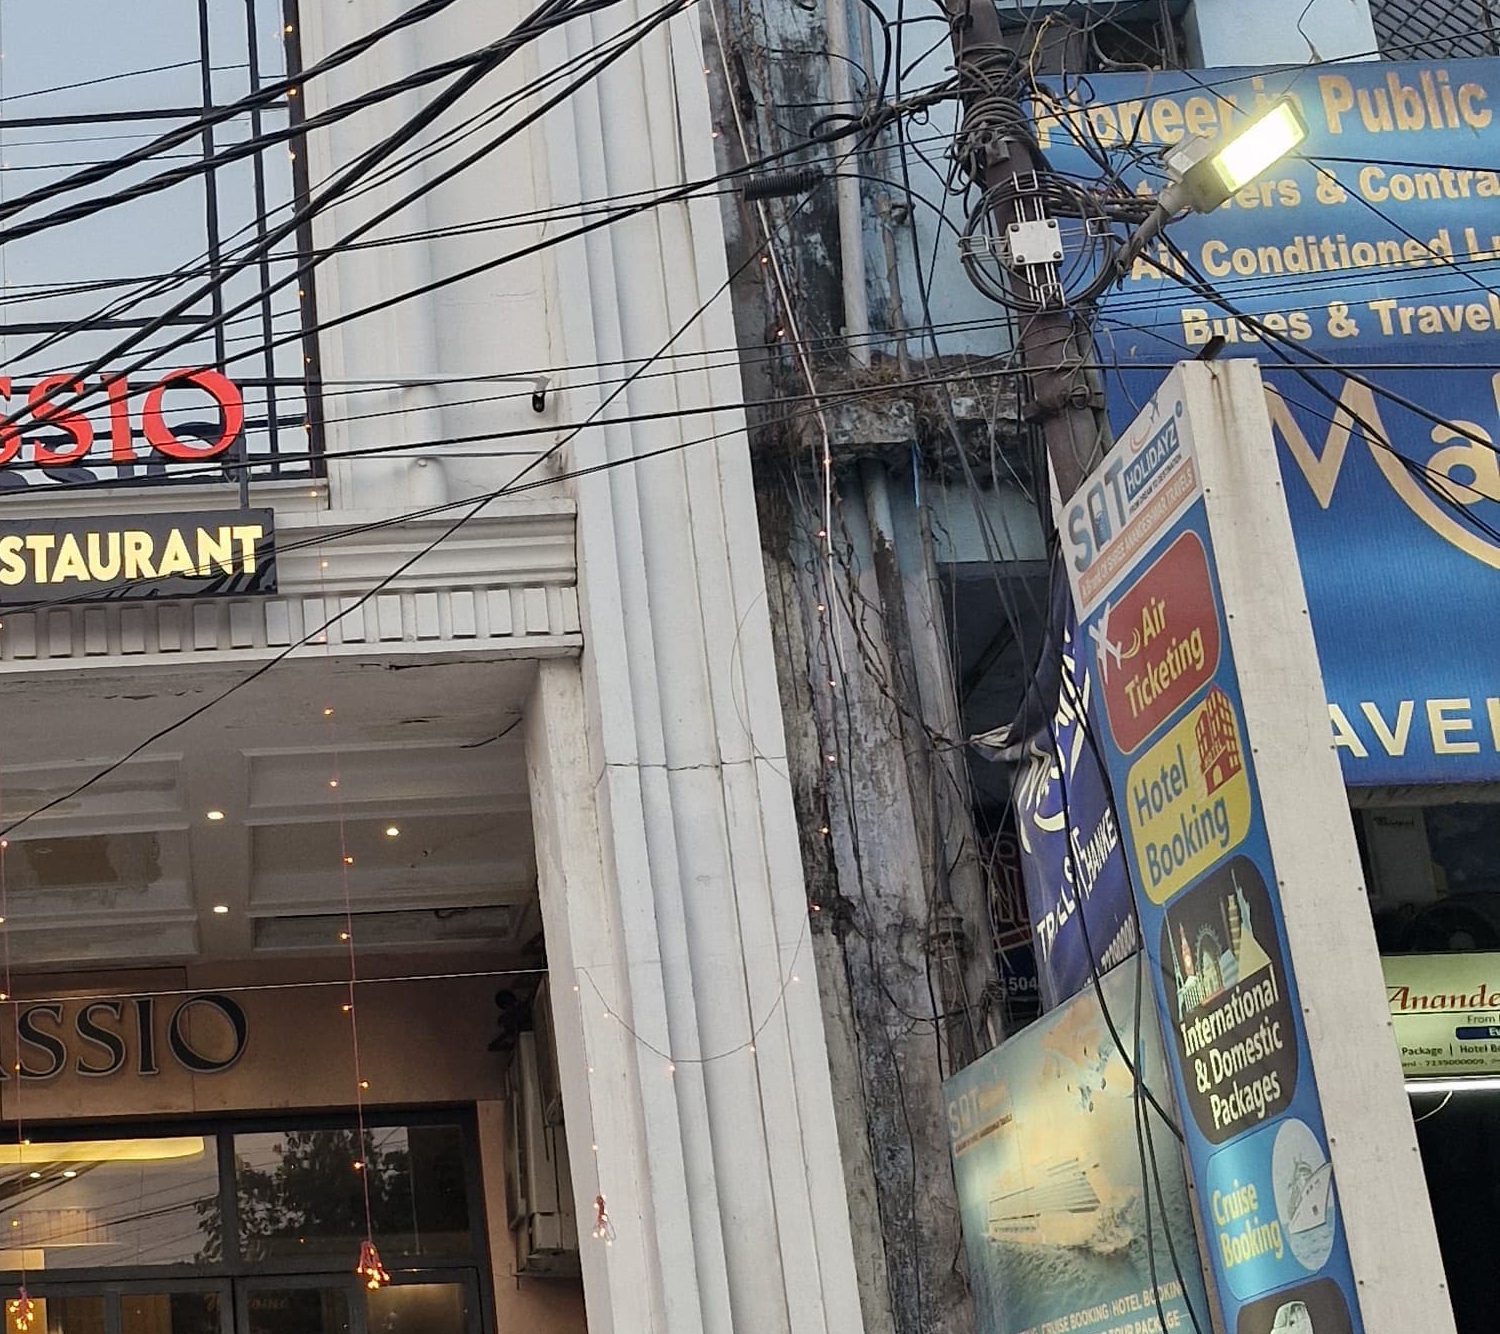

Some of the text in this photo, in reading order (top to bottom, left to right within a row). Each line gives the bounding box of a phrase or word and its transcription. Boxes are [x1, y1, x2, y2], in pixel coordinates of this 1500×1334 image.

[1317, 69, 1493, 135] Public
[1315, 169, 1348, 205] &
[1201, 228, 1452, 278] Conditioned
[1181, 301, 1313, 346] Buses
[1327, 301, 1361, 339] &
[1126, 423, 1179, 496] HOLIDAYZ
[1141, 596, 1167, 647] Air
[1124, 625, 1206, 718] Ticketing
[1133, 743, 1189, 828] Hotel
[1145, 795, 1231, 888] Booking
[1180, 963, 1280, 1059] International
[1467, 1014, 1496, 1025] From
[1194, 1015, 1284, 1094] & Domestic
[1402, 1046, 1443, 1057] Package
[1460, 1044, 1488, 1054] Hotel
[1209, 1070, 1282, 1131] Packages
[1211, 1178, 1259, 1228] Cruise
[1219, 1216, 1285, 1269] Booking
[1069, 1302, 1110, 1329] BOOKING
[1112, 1293, 1142, 1317] HOTEL
